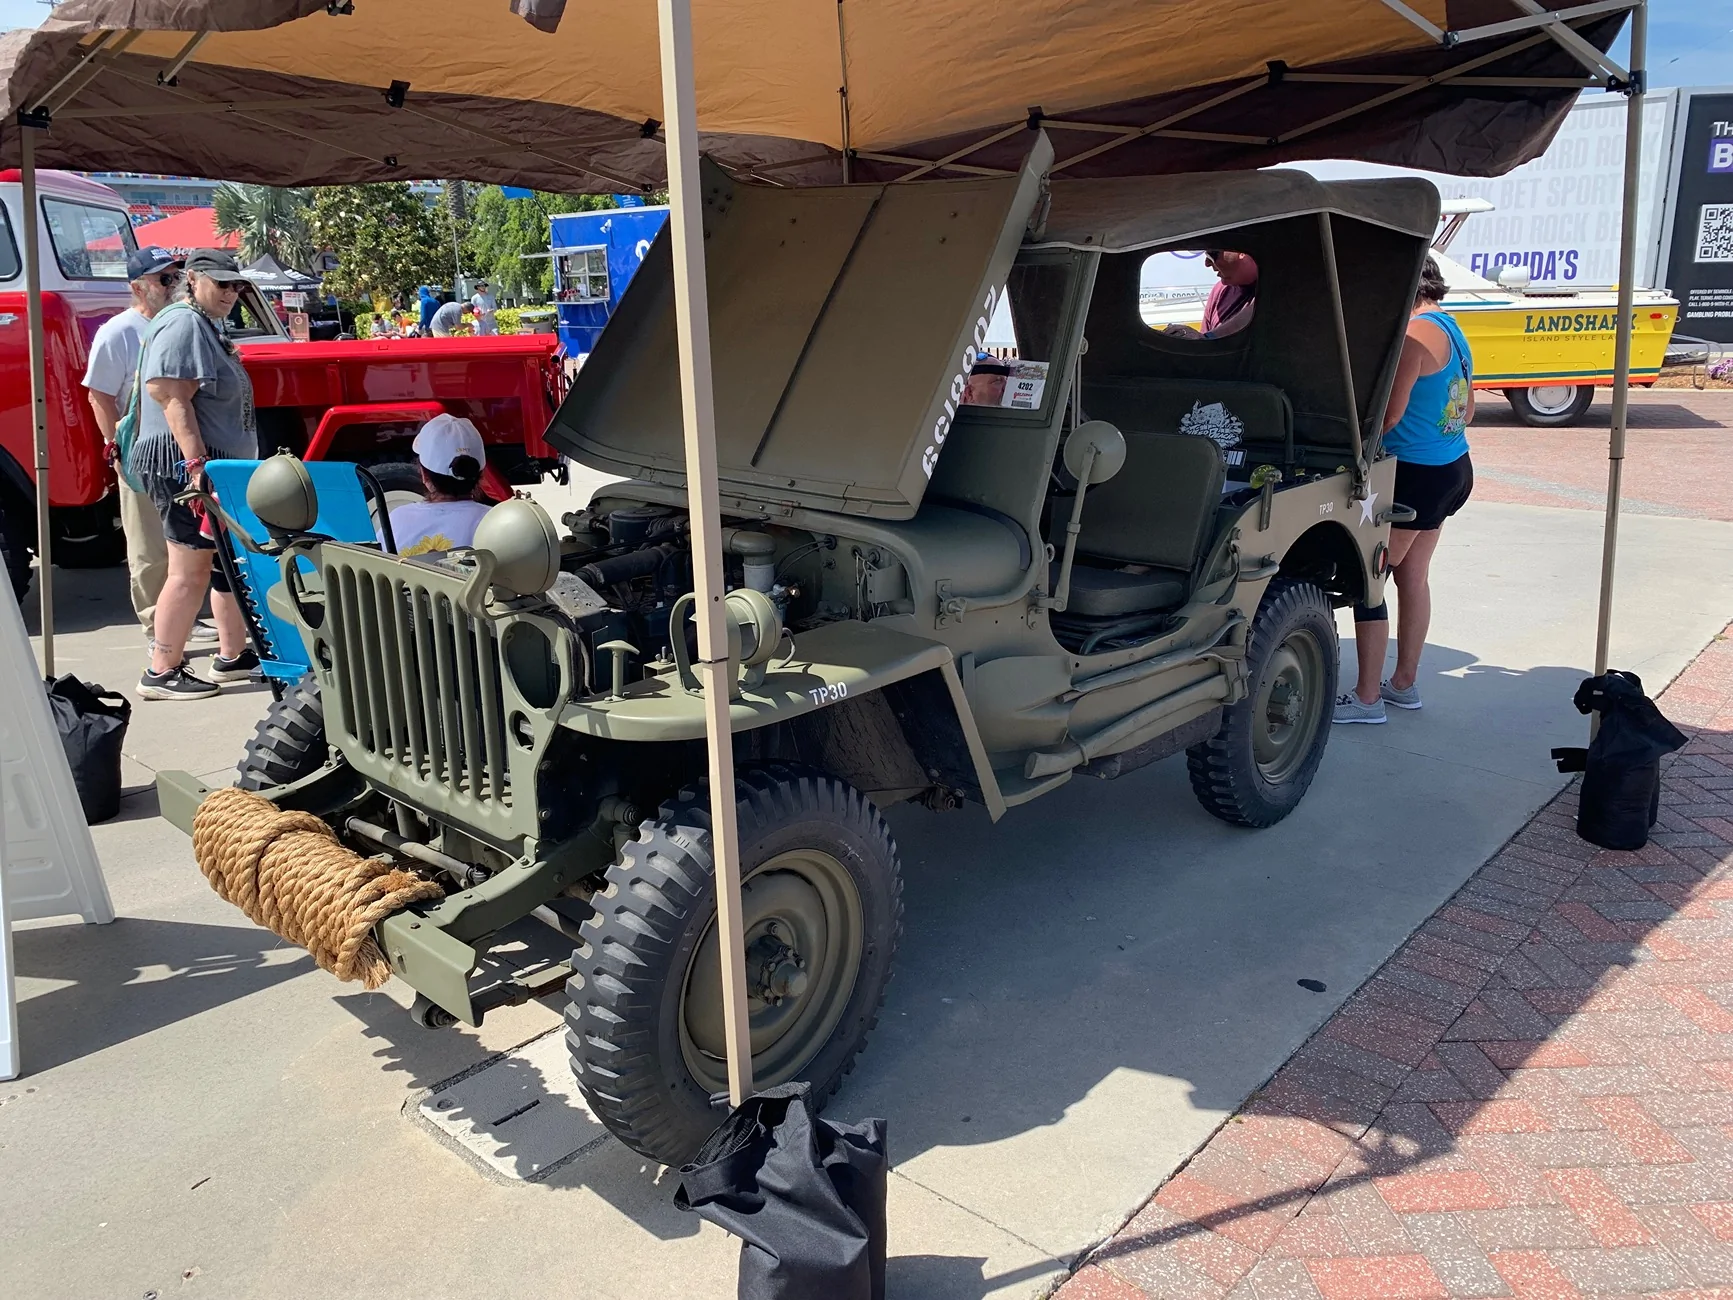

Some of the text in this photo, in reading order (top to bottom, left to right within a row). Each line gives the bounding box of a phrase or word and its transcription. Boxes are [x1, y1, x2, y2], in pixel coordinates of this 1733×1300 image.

[1501, 177, 1542, 210] BET
[1018, 382, 1034, 390] 4202
[1319, 501, 1334, 516] TP30
[808, 681, 848, 706] TP30
